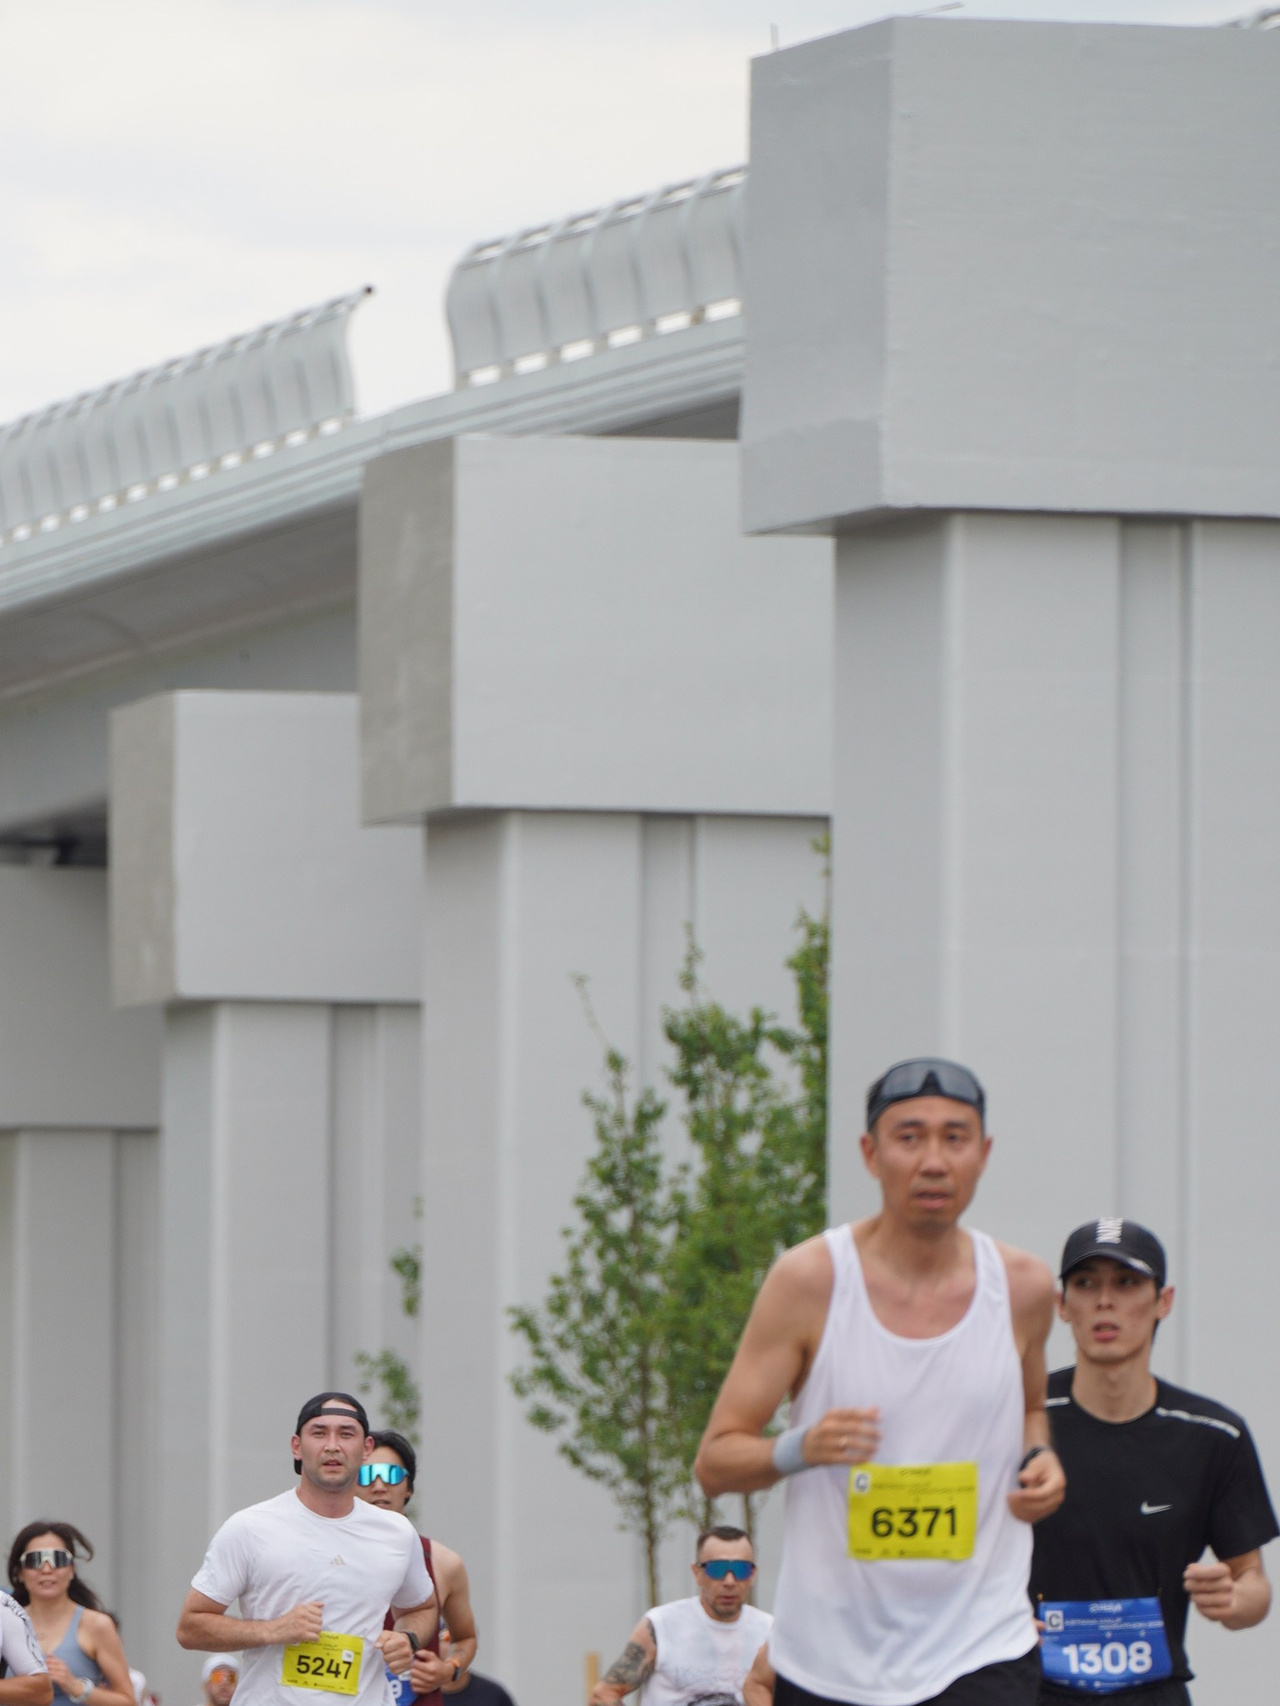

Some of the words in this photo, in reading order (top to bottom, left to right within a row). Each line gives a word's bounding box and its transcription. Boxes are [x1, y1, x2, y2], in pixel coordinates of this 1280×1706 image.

[871, 1504, 957, 1538] 6371
[1048, 1613, 1061, 1629] C
[296, 1654, 353, 1680] 5247
[1061, 1640, 1153, 1675] 1308
